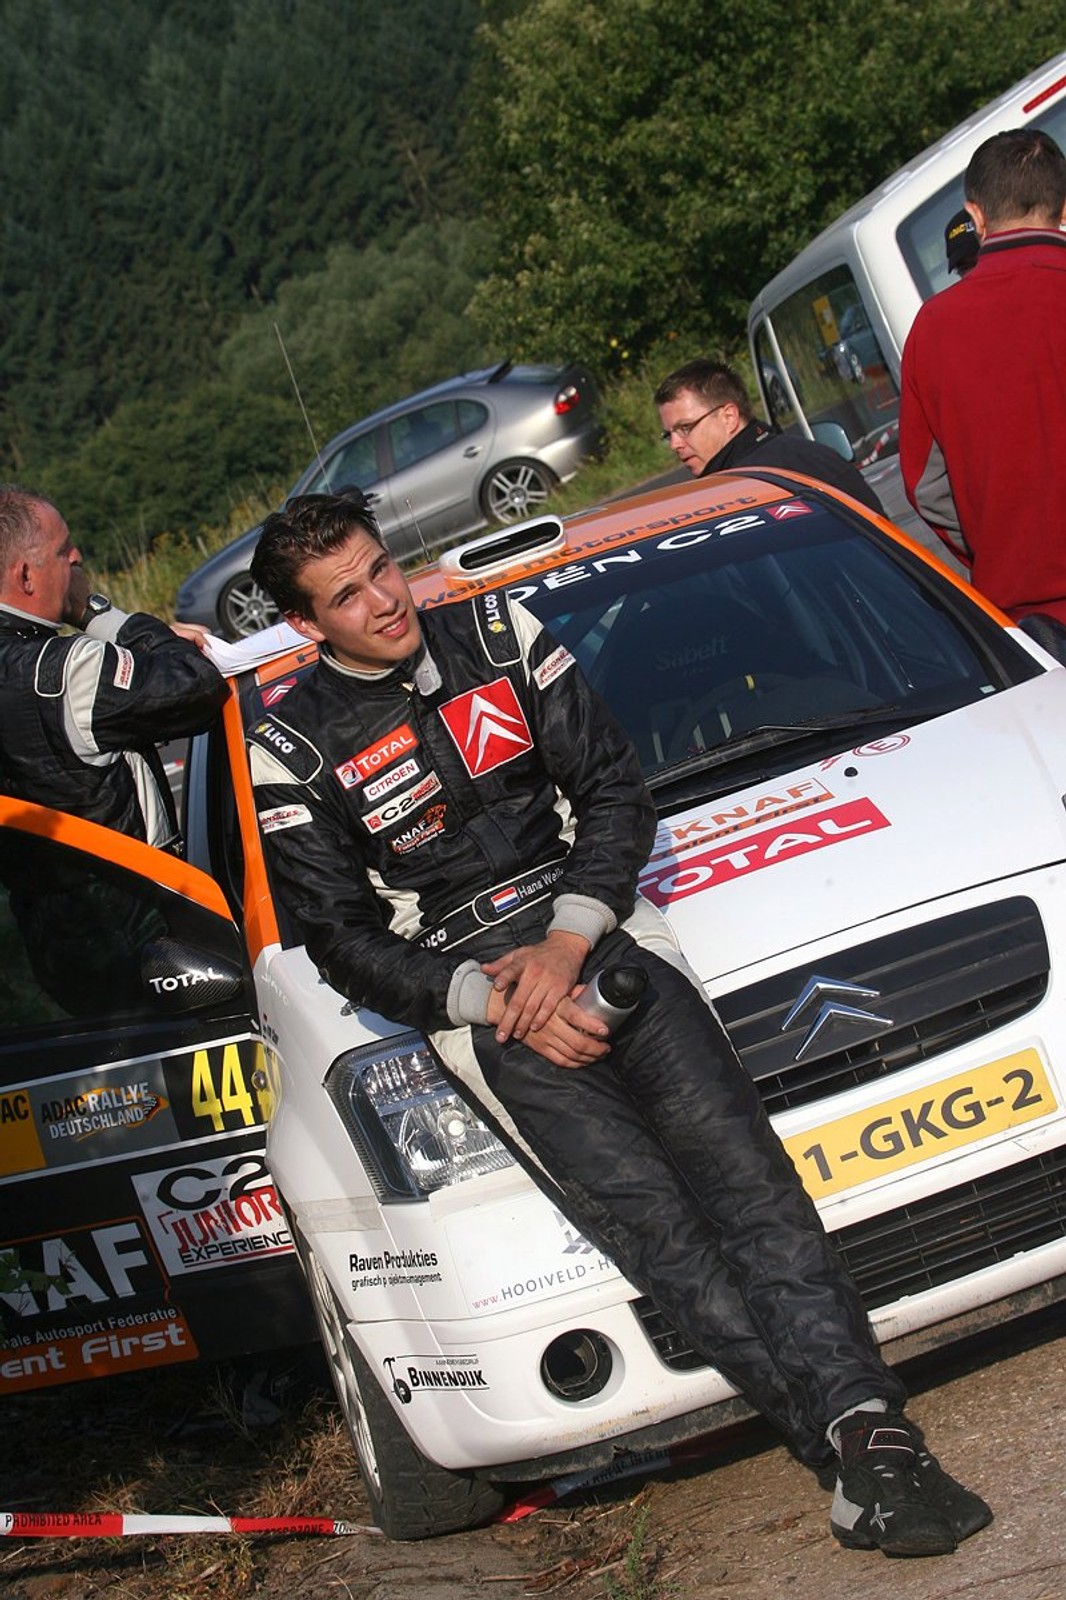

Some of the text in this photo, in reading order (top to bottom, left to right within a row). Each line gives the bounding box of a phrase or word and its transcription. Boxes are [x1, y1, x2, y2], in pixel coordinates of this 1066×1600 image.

[523, 494, 757, 569] motorsport
[656, 514, 766, 550] C2
[356, 736, 414, 770] TOTAL
[671, 781, 814, 840] KNAF
[392, 820, 427, 847] KNAF
[517, 880, 544, 899] Hans
[149, 966, 224, 994] TOTAL
[41, 1081, 150, 1124] ADAC RALLYE
[50, 1106, 145, 1139] DEUTSCHLAND
[156, 1154, 270, 1211] C2
[168, 1185, 284, 1251] JUNIOR
[349, 1248, 438, 1272] Raven Produkties
[351, 1275, 382, 1291] grafisch
[36, 1320, 105, 1344] Autosport
[107, 1307, 177, 1330] Federatie
[81, 1322, 186, 1365] First
[5, 1513, 102, 1528] PROHIBITED AREA
